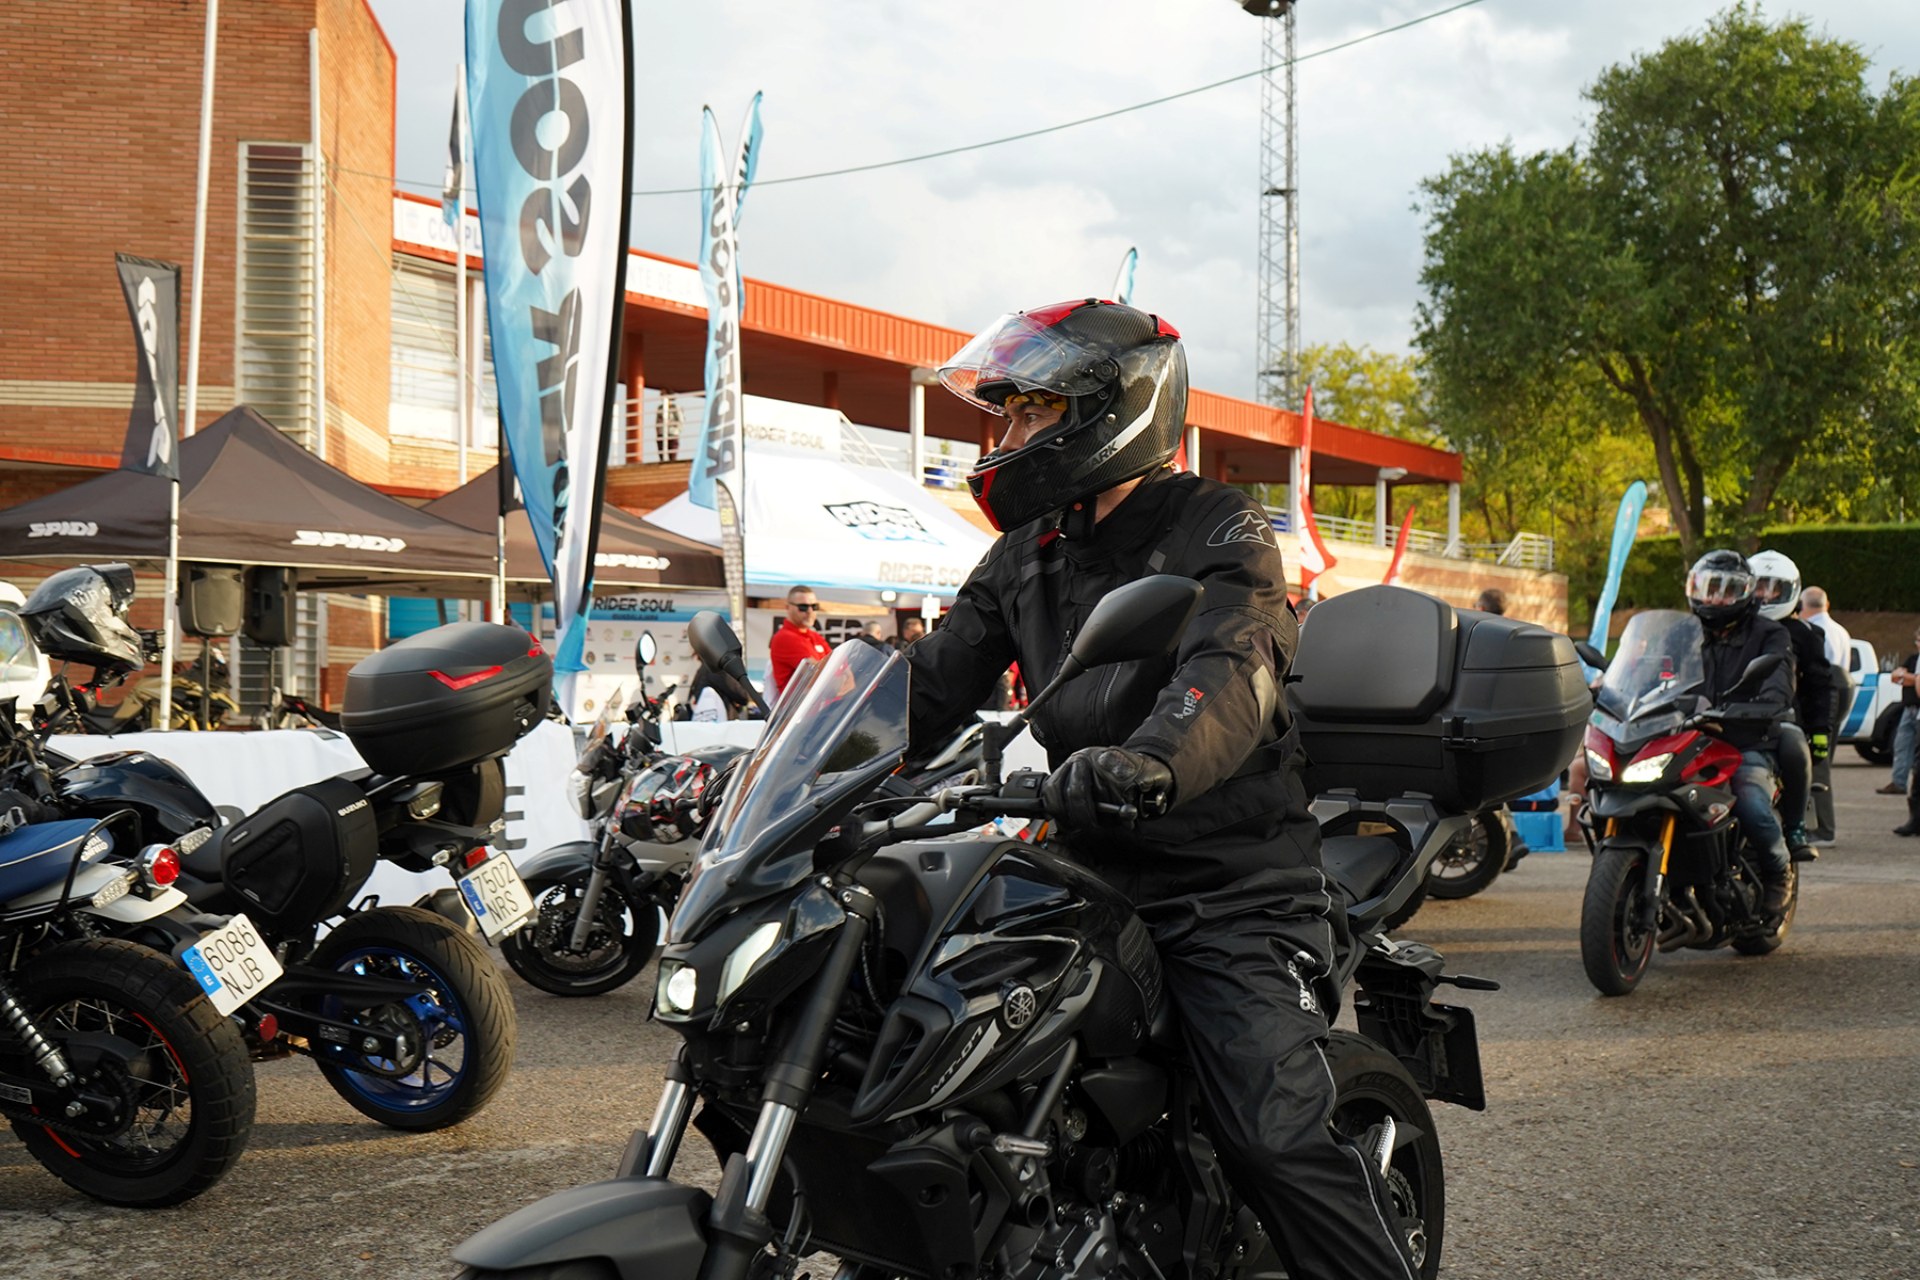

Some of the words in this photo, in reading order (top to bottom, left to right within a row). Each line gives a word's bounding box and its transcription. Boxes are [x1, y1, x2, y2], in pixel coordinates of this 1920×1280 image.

[28, 521, 99, 538] SPIDI
[291, 530, 407, 553] SPIDI
[878, 560, 933, 586] RIDER
[937, 566, 968, 588] SO
[593, 597, 637, 612] RIDER
[639, 598, 676, 613] SOUL
[338, 799, 368, 817] SUZUKI
[472, 861, 516, 900] 7502
[473, 900, 482, 911] E
[485, 890, 519, 925] NRS
[203, 923, 257, 972] 6086
[203, 975, 215, 987] E
[220, 957, 265, 1001] NJB
[930, 1024, 983, 1095] MT-07
